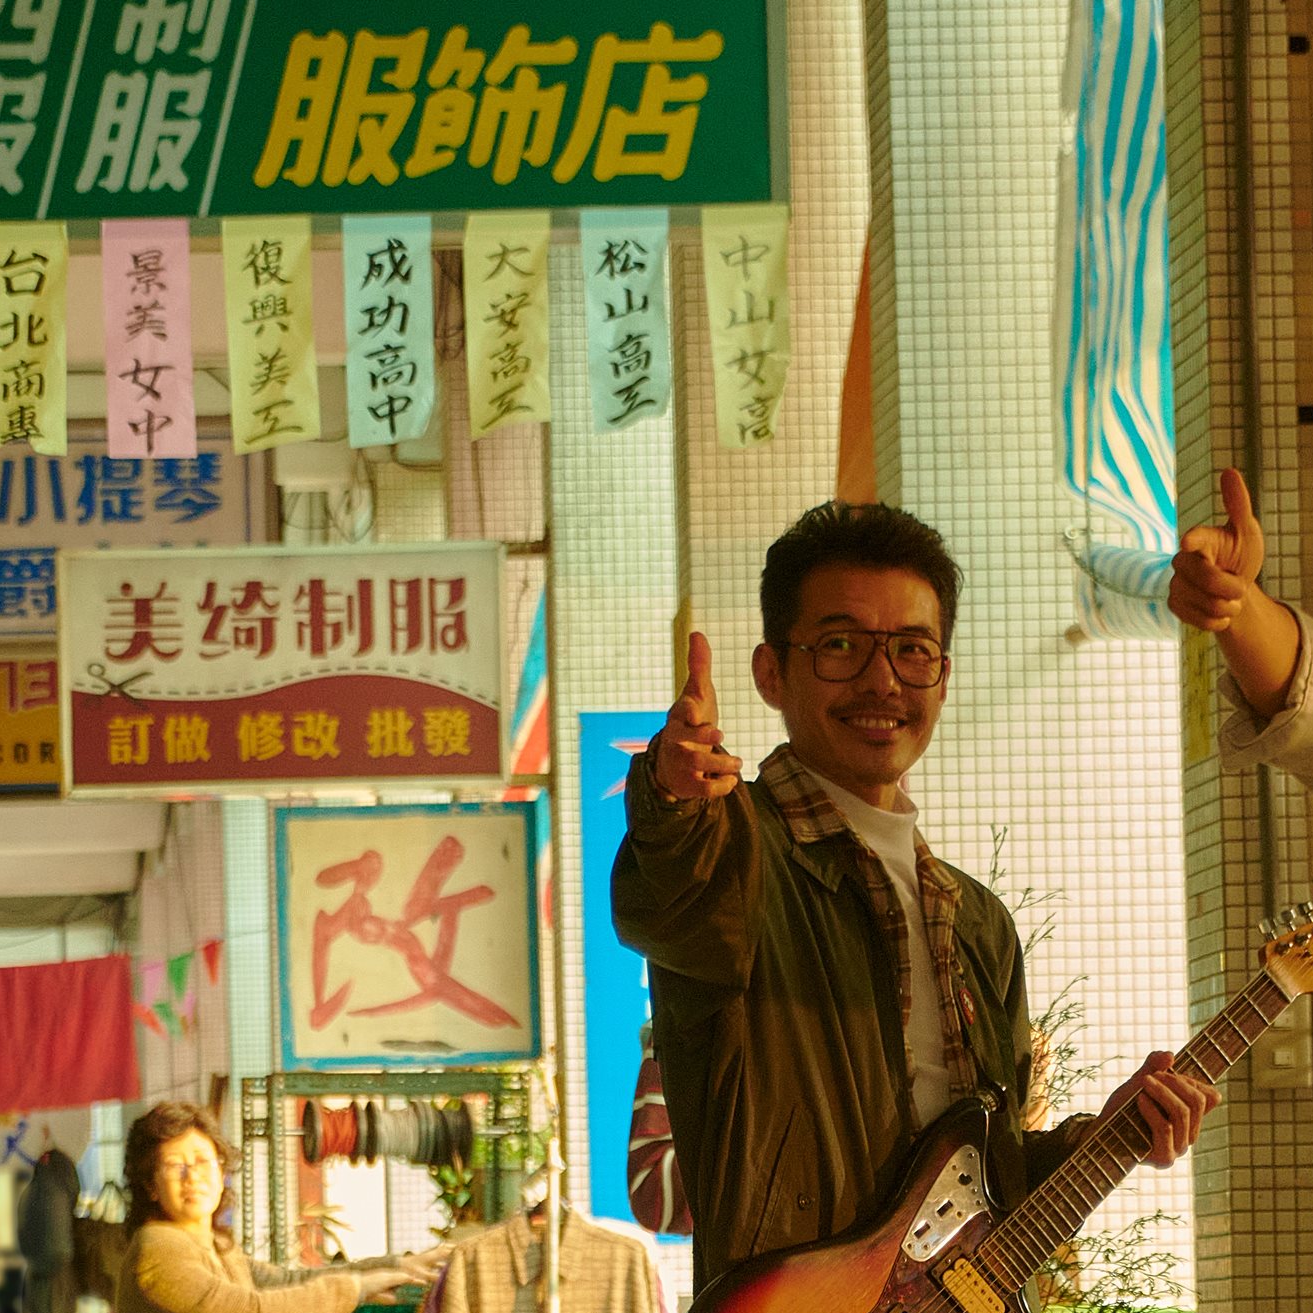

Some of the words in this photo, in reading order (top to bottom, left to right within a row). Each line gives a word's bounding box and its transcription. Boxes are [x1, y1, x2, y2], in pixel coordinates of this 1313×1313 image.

[253, 22, 724, 187] 服飾店
[118, 250, 176, 456] 景美女中
[242, 239, 302, 444] 復興美工
[357, 238, 418, 438] 成功高中
[480, 243, 534, 430] 大安高工
[594, 239, 658, 425] 松山高工
[719, 236, 778, 444] 中山女高
[237, 711, 341, 763] 修改
[308, 835, 522, 1030] 改
